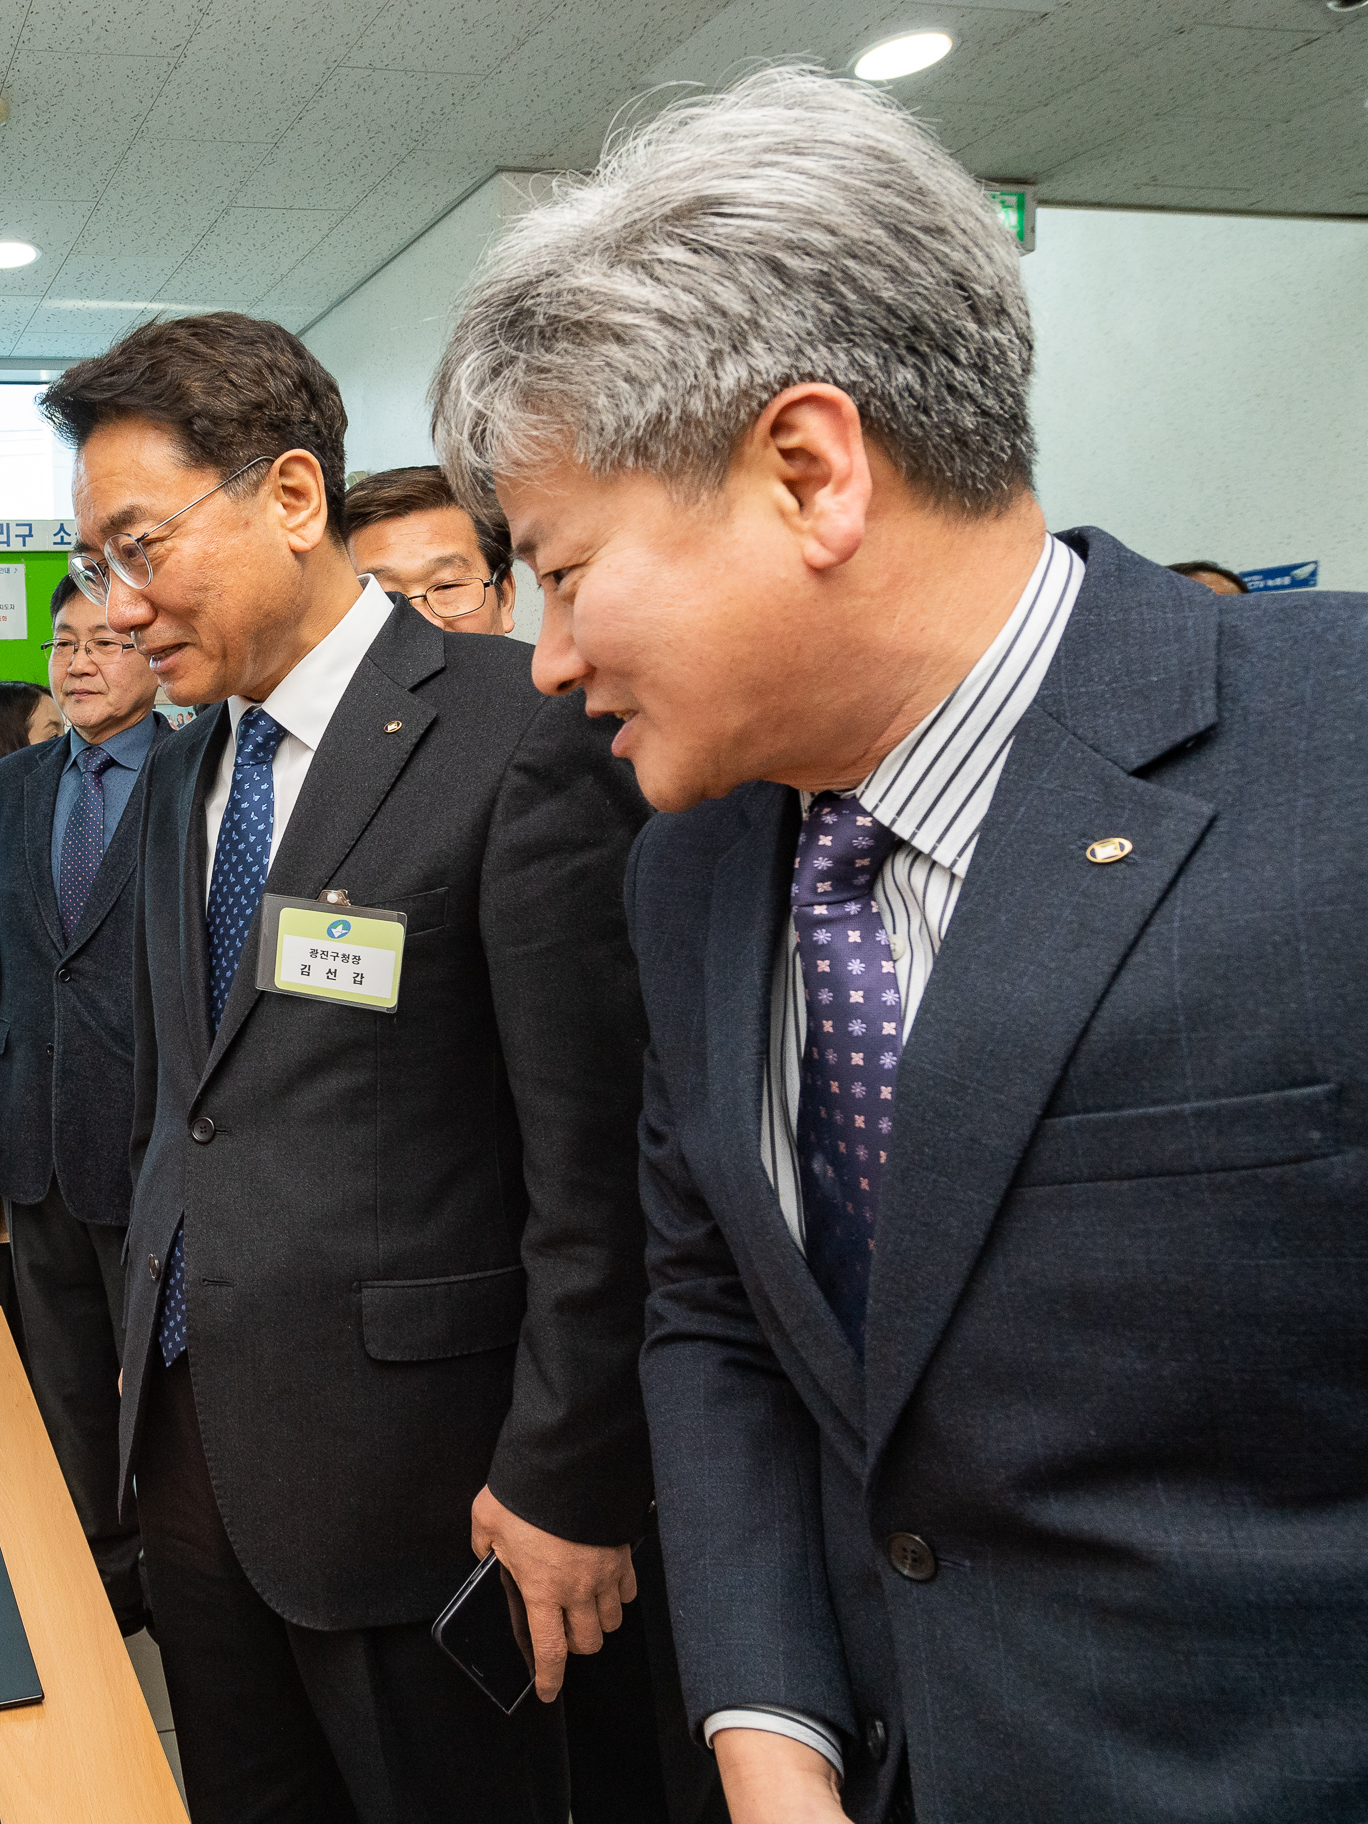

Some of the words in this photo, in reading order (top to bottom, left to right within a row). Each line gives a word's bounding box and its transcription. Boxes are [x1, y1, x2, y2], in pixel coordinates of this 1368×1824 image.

[52, 523, 77, 546] 소
[309, 948, 362, 966] 광진구청장
[300, 964, 312, 977] 김
[326, 968, 338, 981] 선
[352, 972, 365, 986] 갑
